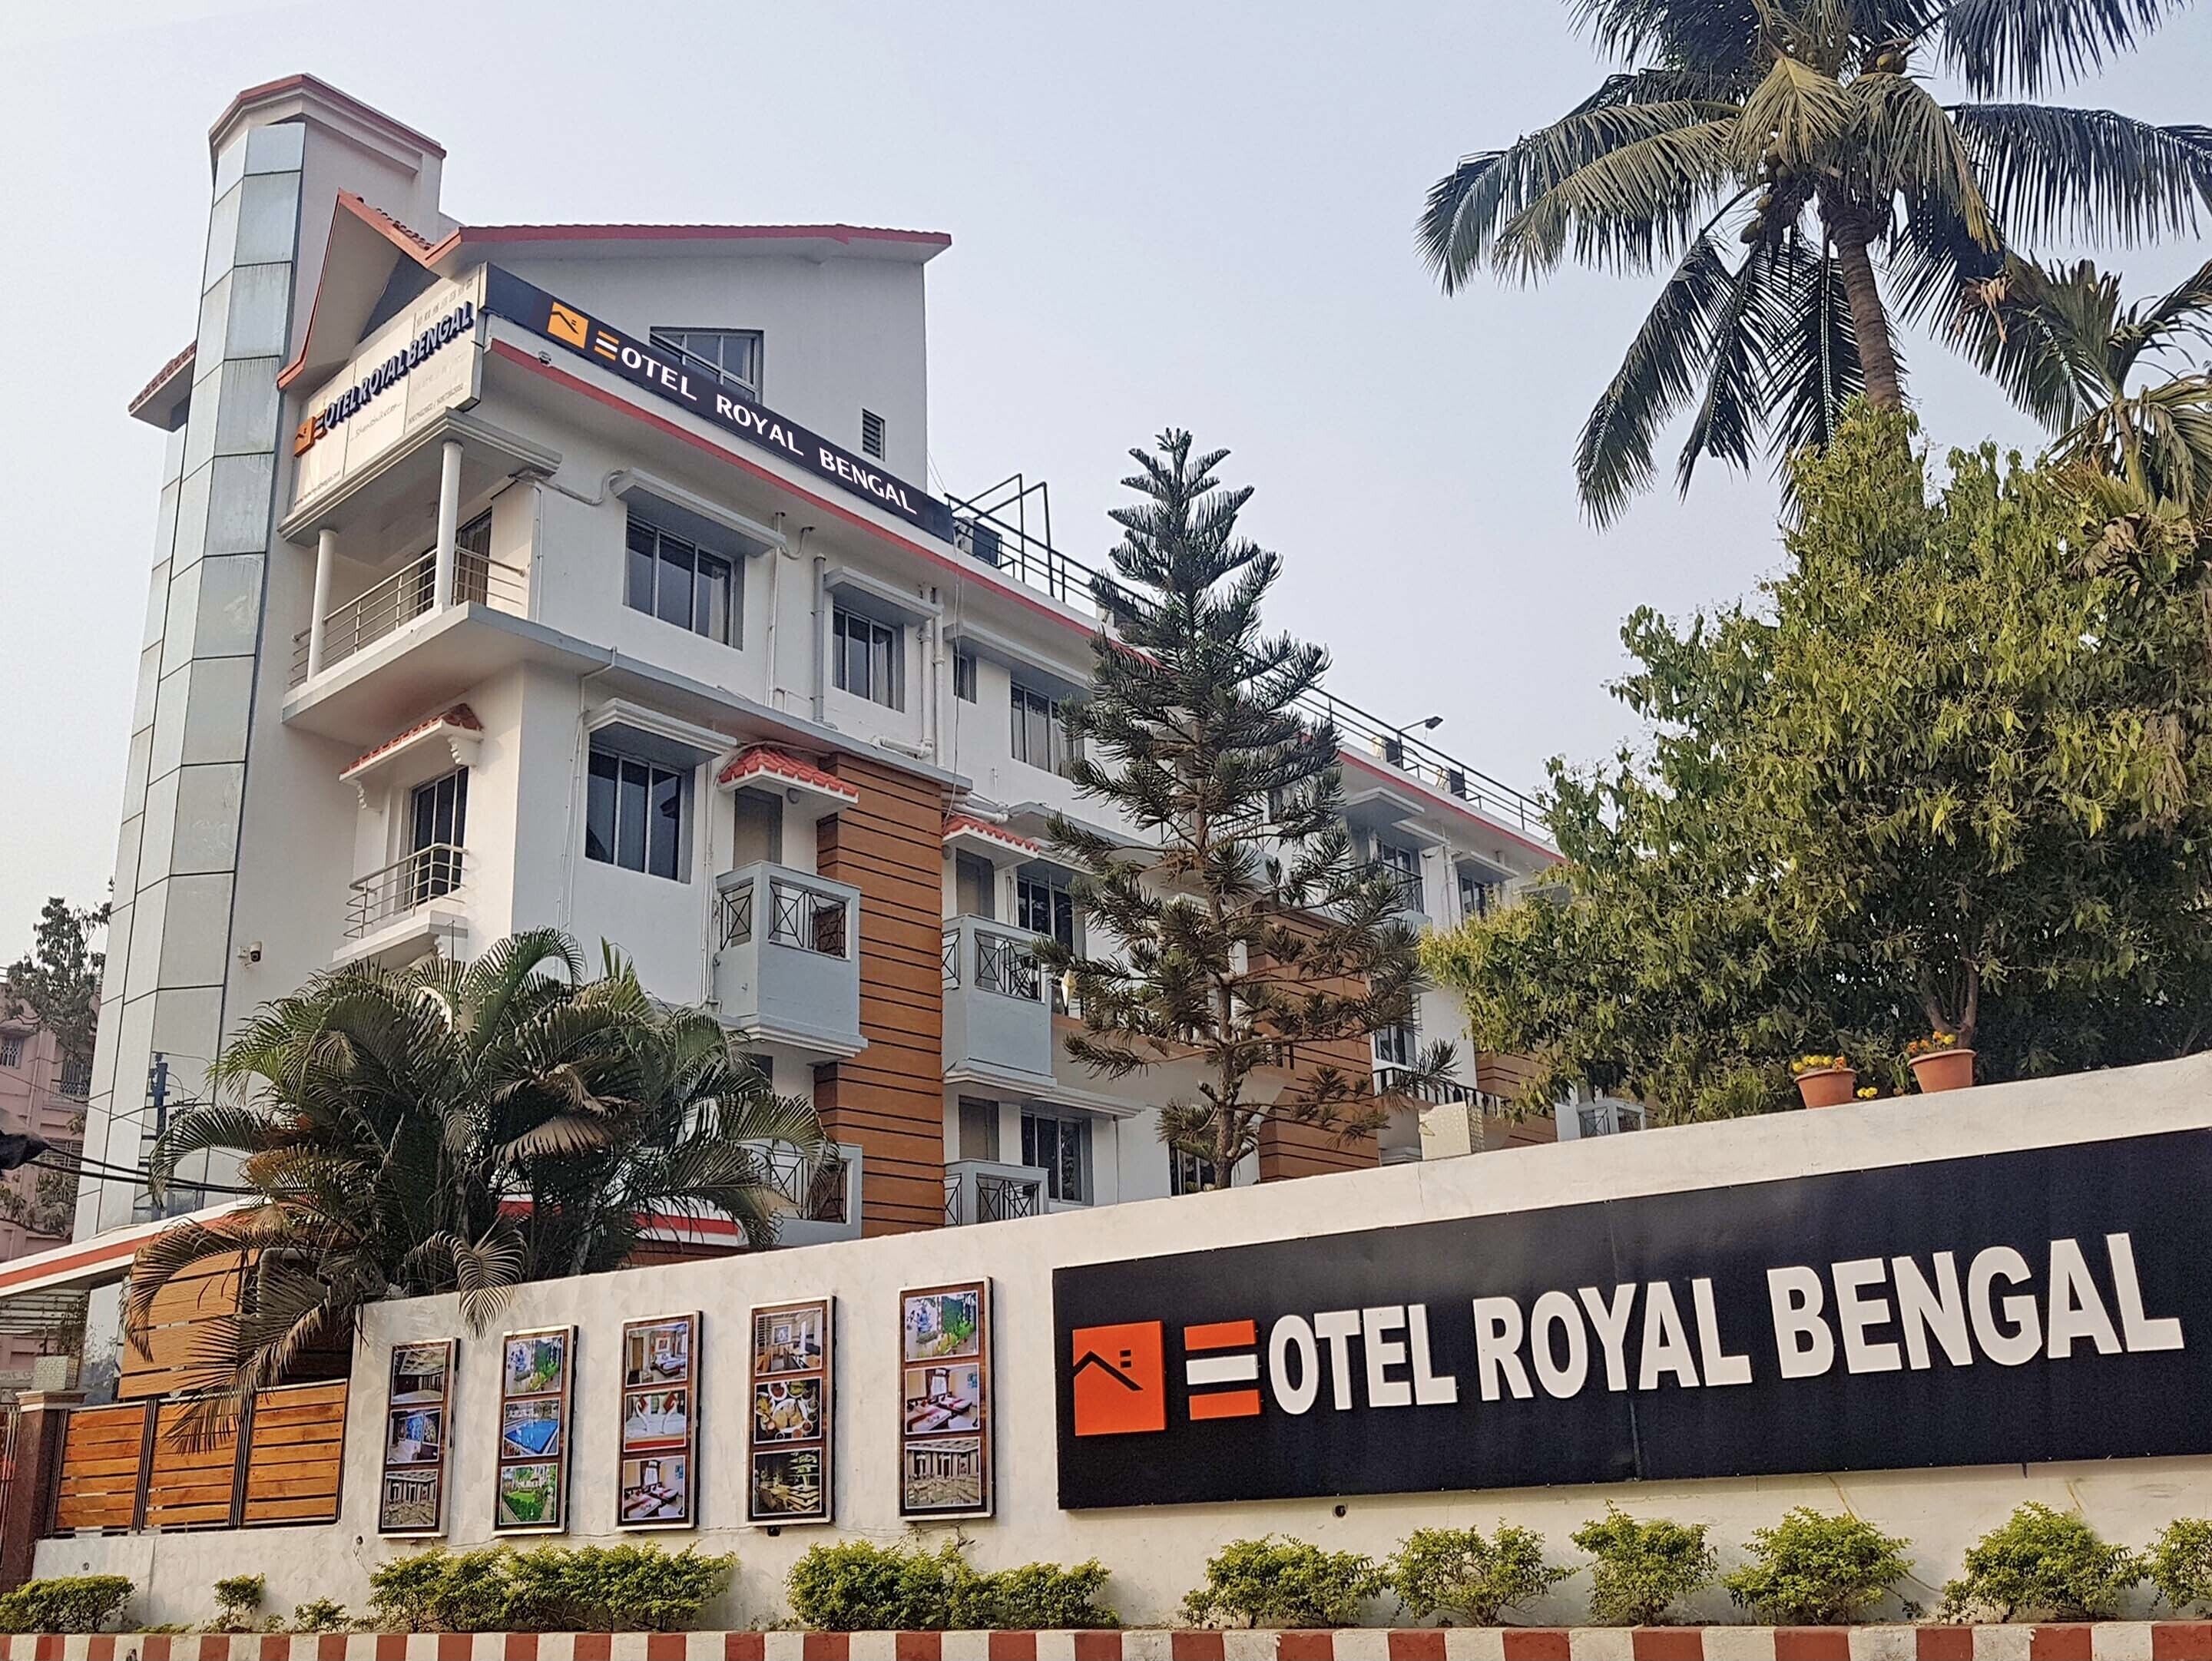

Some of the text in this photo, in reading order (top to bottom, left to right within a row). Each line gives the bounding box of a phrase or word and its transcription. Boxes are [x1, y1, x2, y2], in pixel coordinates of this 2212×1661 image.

[358, 349, 409, 405] ROYAL
[406, 301, 473, 369] BENGAL
[716, 393, 804, 457] ROYAL
[819, 447, 918, 515] BENGAL
[1472, 1278, 1753, 1402] ROYAL
[1767, 1232, 2186, 1380] BENGAL
